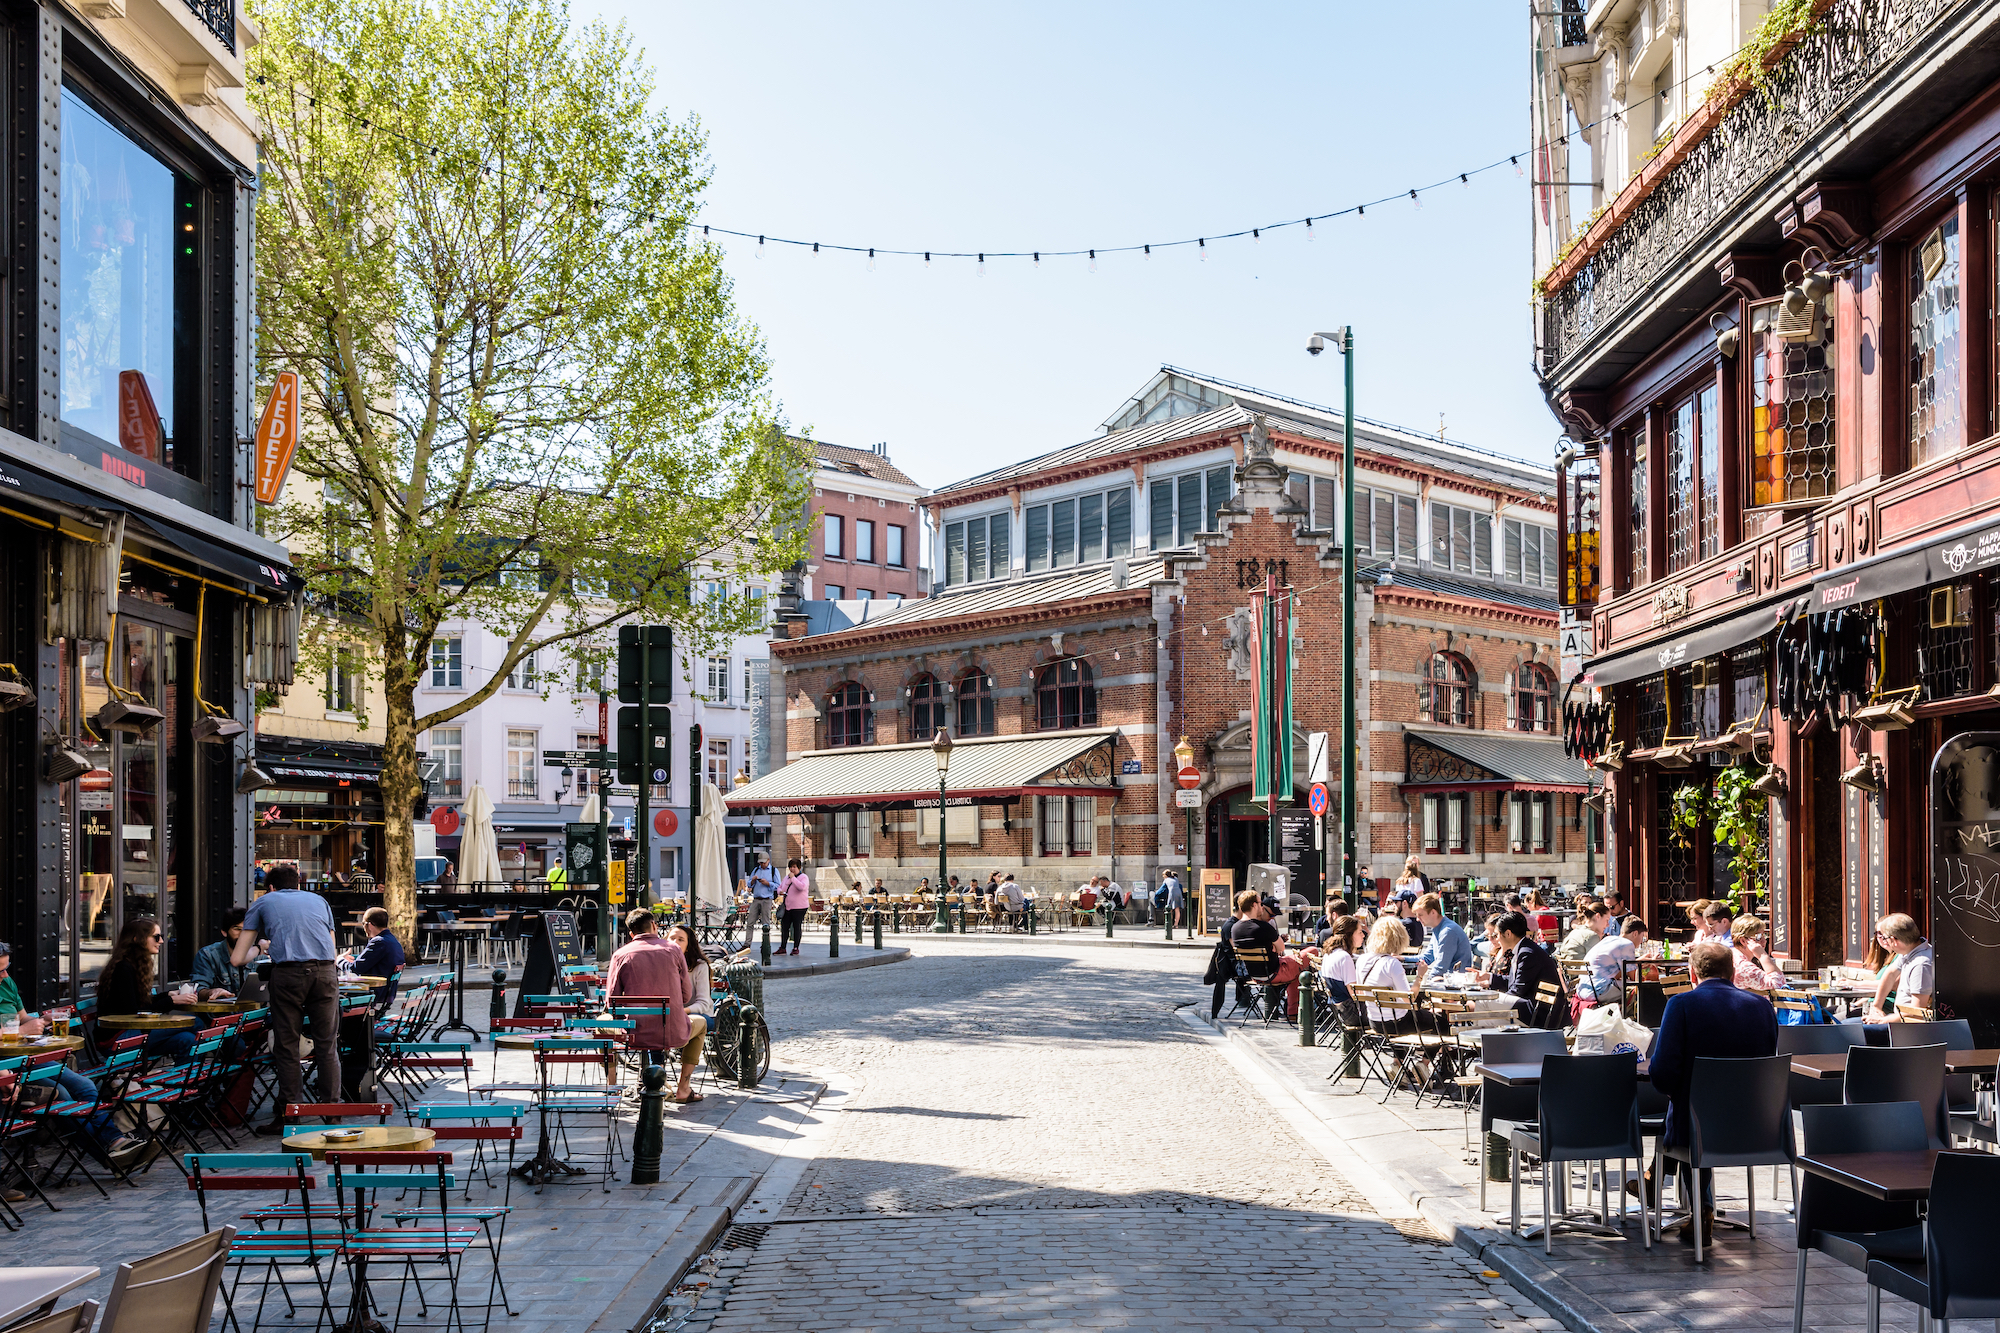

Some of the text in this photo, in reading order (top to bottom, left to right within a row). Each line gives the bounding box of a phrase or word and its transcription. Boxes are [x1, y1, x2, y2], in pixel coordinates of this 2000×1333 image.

[261, 382, 292, 495] VEDETT
[1790, 543, 1809, 560] LILLET
[1651, 583, 1688, 614] JAMESON
[1822, 581, 1856, 605] VEDETT
[752, 681, 760, 715] ORLEY
[752, 718, 760, 738] VAN
[952, 797, 972, 805] District
[87, 824, 99, 835] ROI
